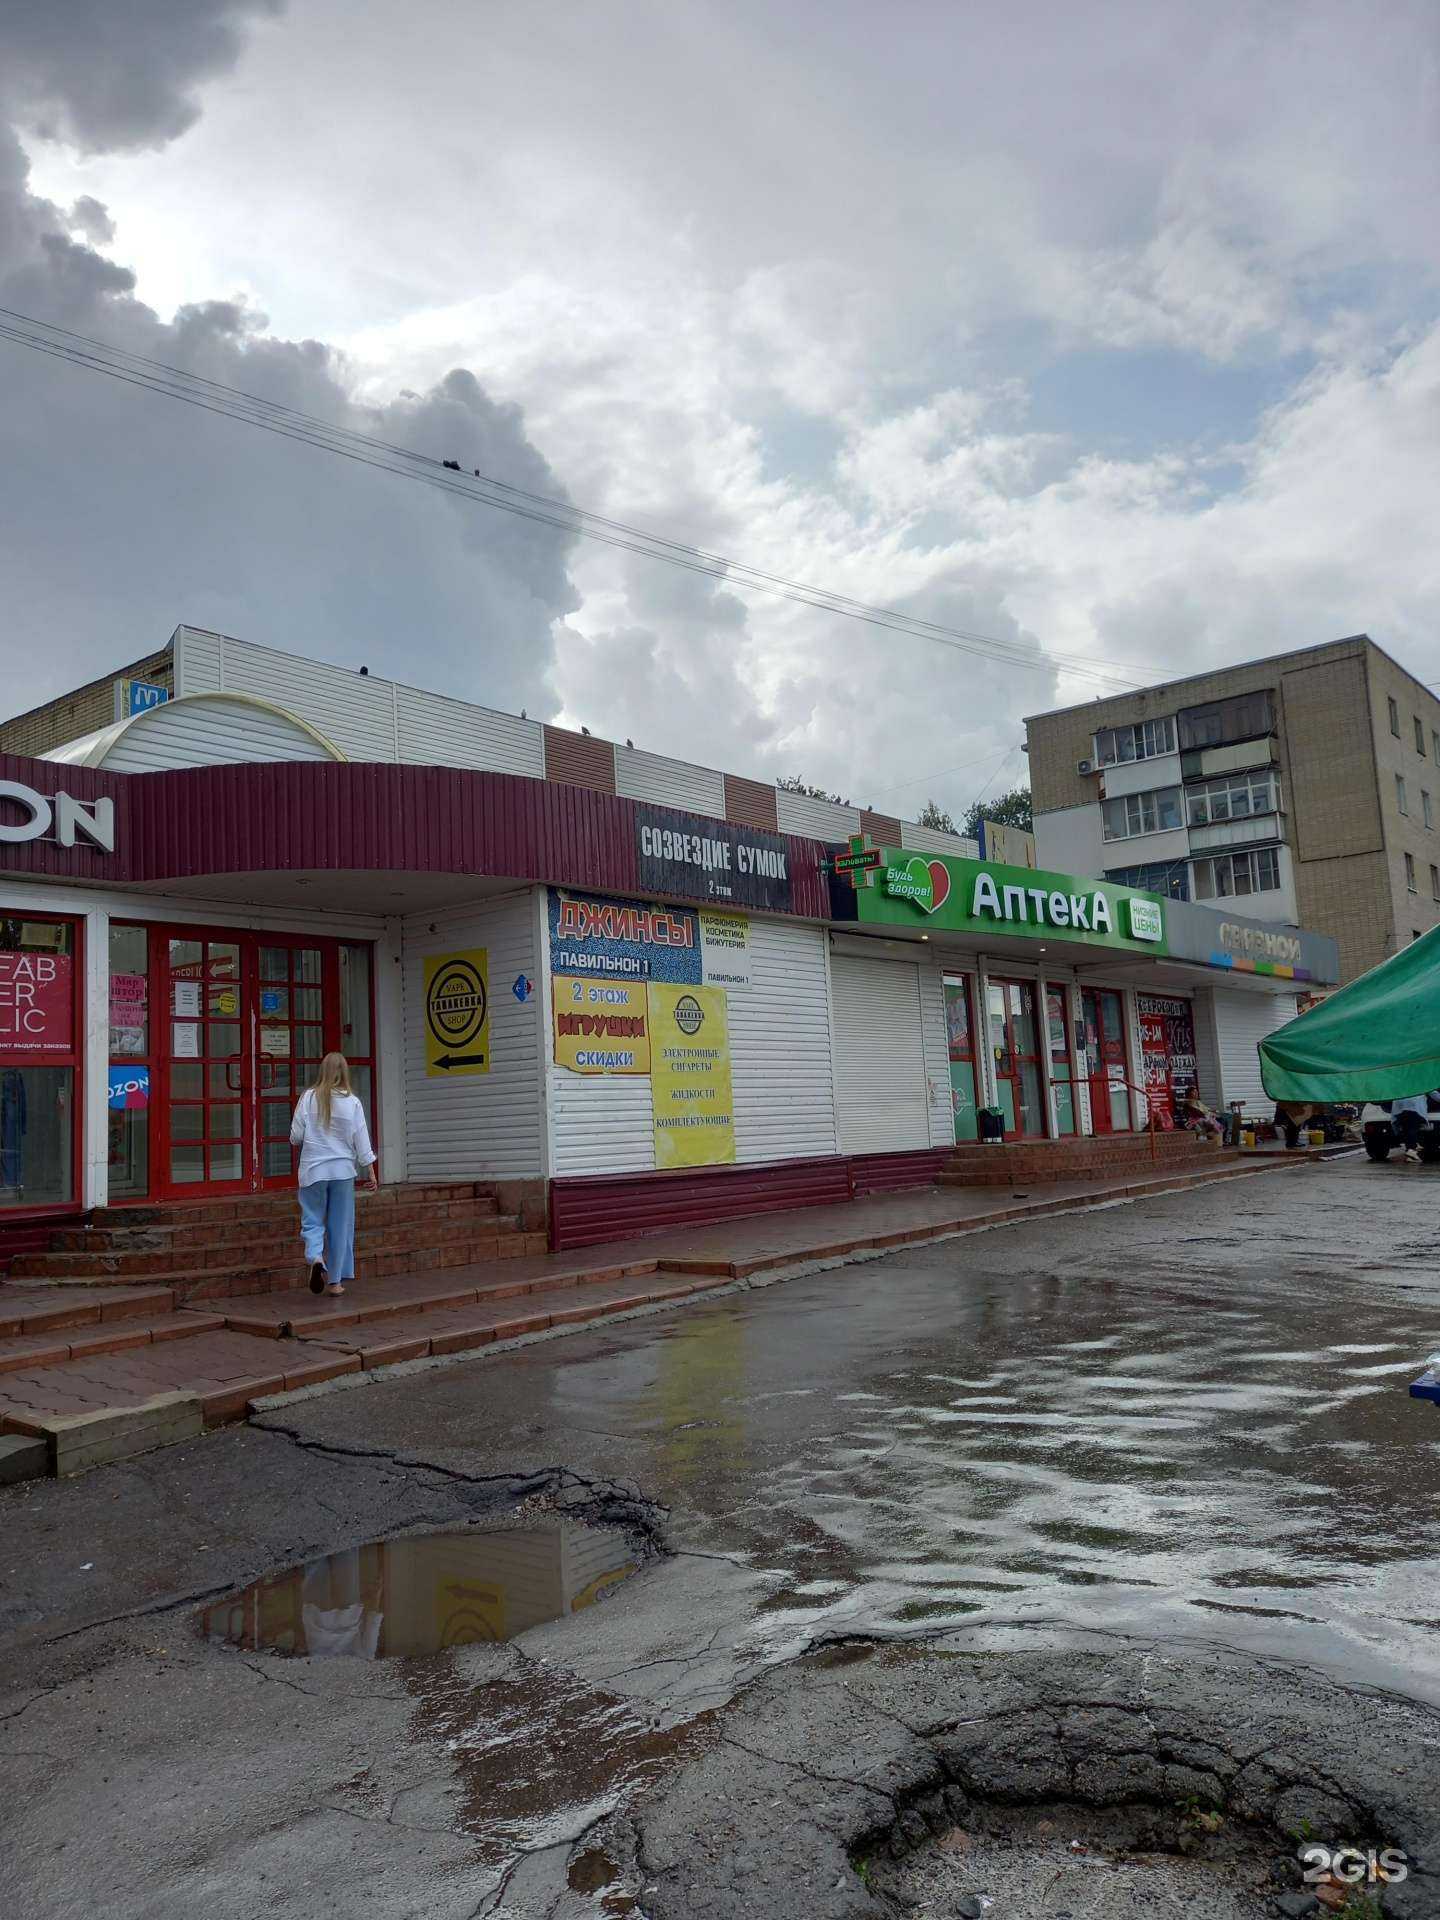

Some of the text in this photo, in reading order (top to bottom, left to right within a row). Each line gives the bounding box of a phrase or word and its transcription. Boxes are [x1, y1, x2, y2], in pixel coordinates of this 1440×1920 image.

[641, 825, 787, 880] СОЗВЕЗДИЕ СУМОК
[887, 867, 913, 882] Будь
[708, 880, 732, 897] 2 этаж
[887, 884, 931, 898] здоров!
[557, 900, 693, 947] ДЖИНСЫ
[701, 915, 749, 930] ПАРФЮМЕРИЯ
[1135, 917, 1160, 934] ЦЕНЫ
[705, 926, 745, 940] КОСМЕТИКА
[705, 937, 746, 950] БИЖУТЕРИЯ
[642, 959, 649, 974] 1
[745, 976, 749, 984] 1
[572, 982, 630, 1004] 2 этаж
[0, 1008, 46, 1033] IC
[557, 1012, 646, 1038] ИГРУШКИ
[575, 1050, 634, 1068] СКИДКИ
[663, 1048, 720, 1058] ЭЛЕКТРОННЫЕ
[671, 1062, 712, 1072] СИГАРЕТЫ
[671, 1089, 716, 1099] ЖИДКОСТИ
